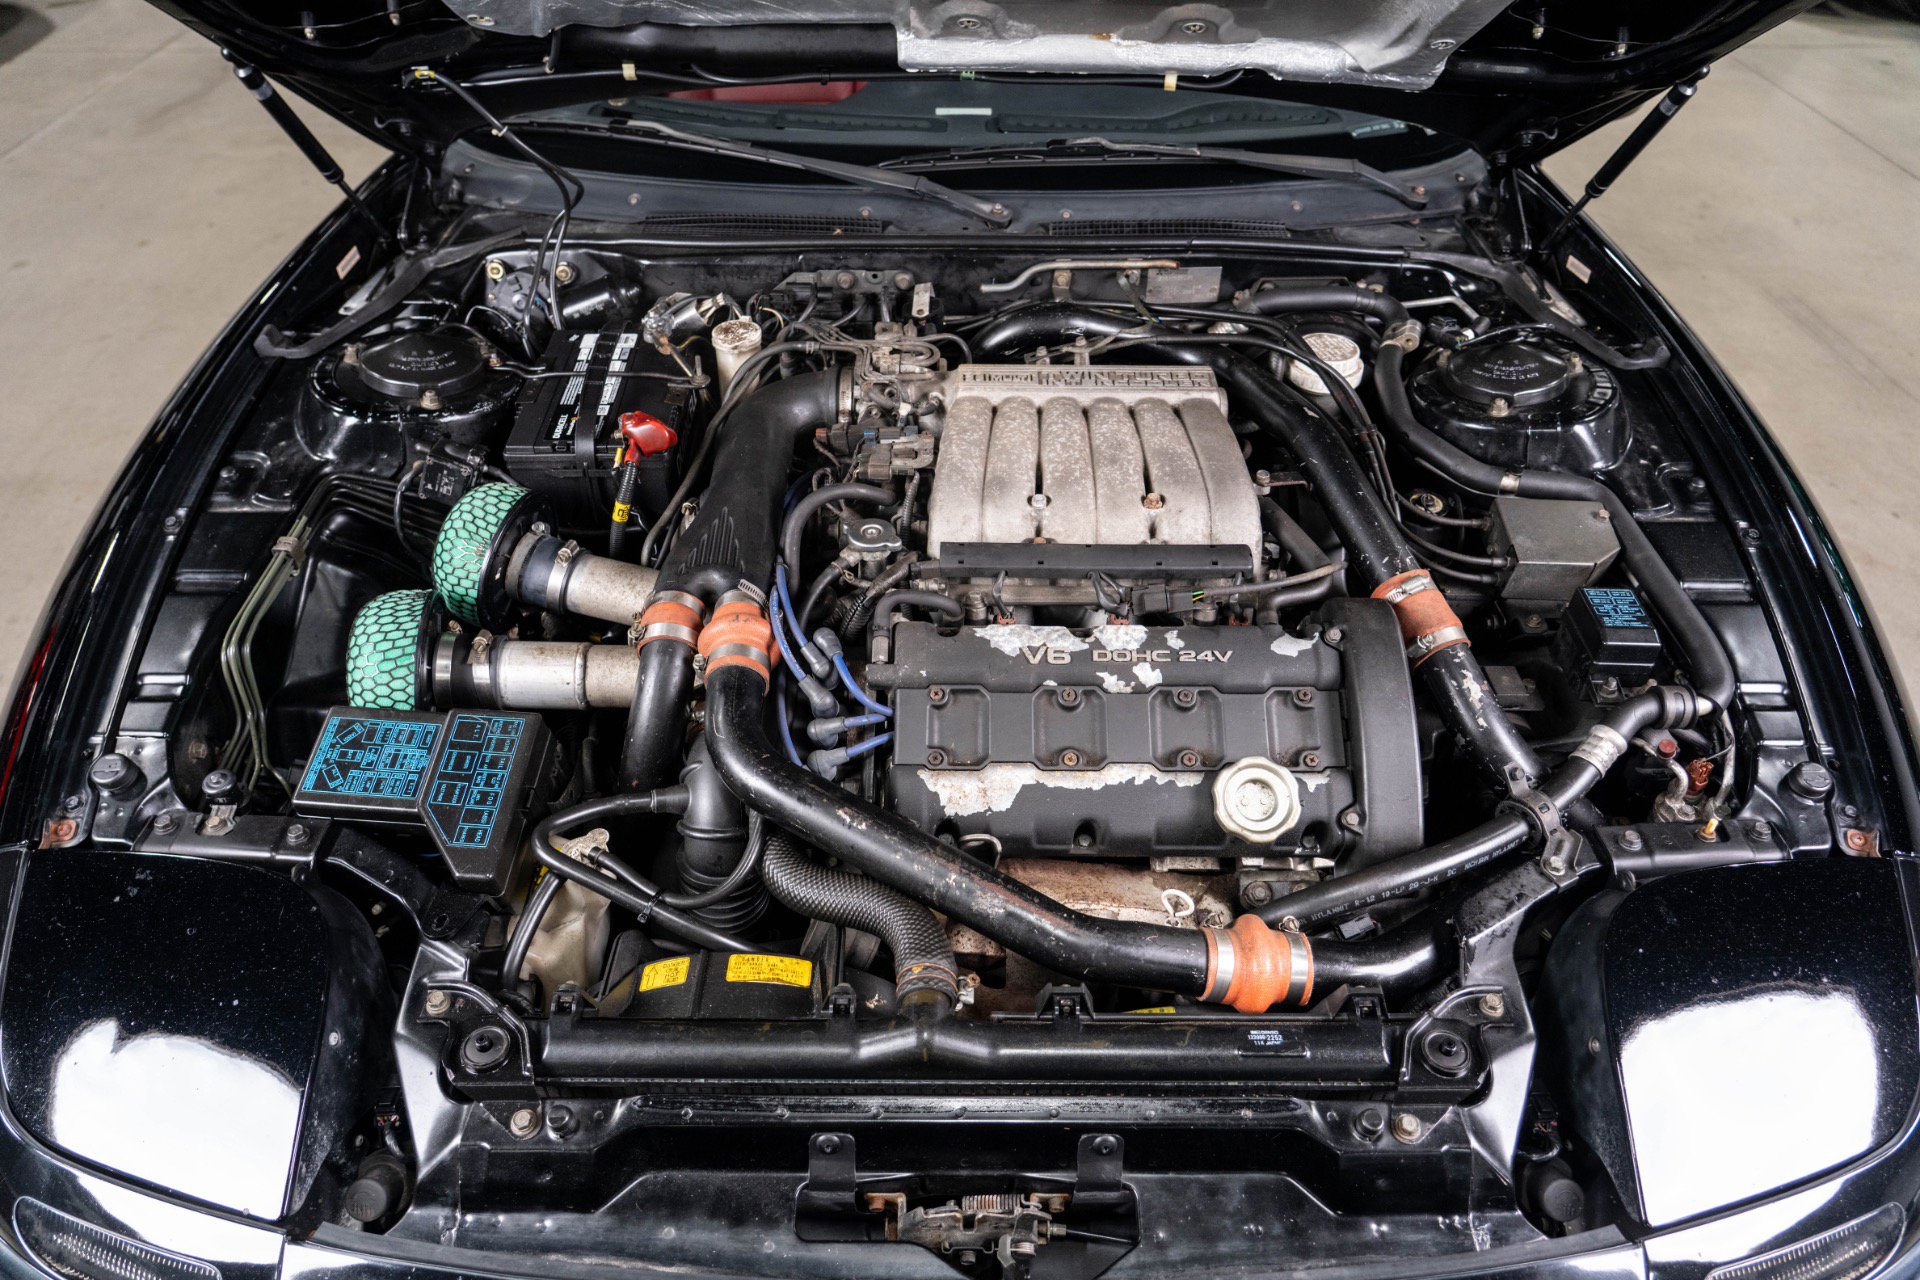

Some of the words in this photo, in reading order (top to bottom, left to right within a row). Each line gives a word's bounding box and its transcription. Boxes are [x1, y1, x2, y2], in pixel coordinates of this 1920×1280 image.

[552, 414, 568, 439] DURACELL
[1021, 645, 1071, 665] V6
[1092, 650, 1171, 662] DOHC
[1178, 650, 1233, 663] 24V
